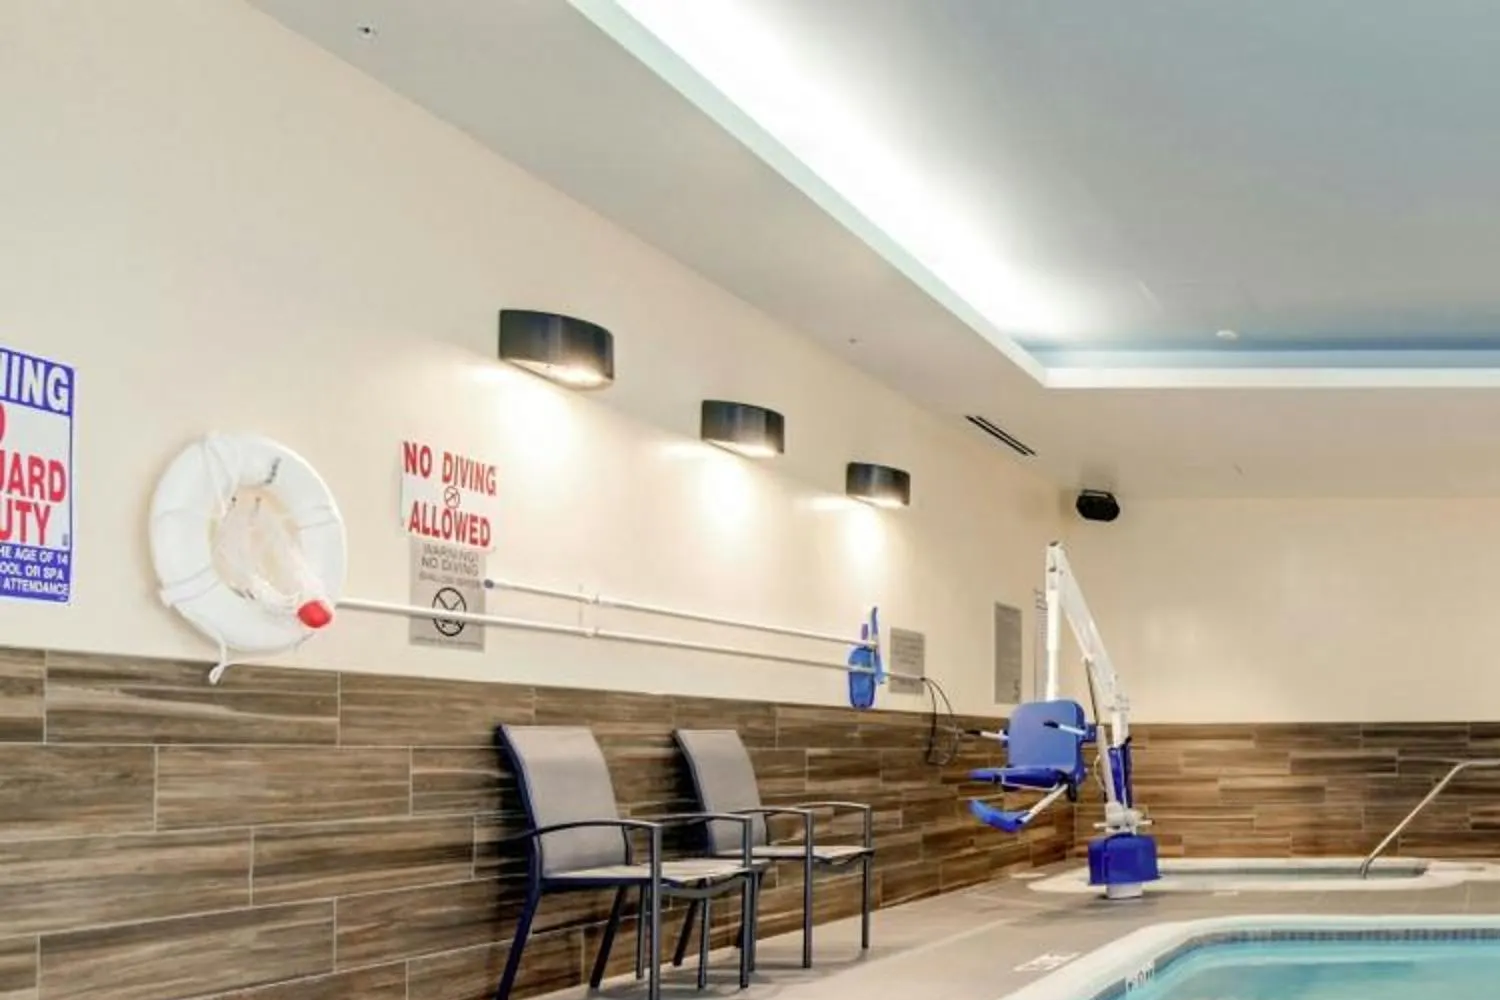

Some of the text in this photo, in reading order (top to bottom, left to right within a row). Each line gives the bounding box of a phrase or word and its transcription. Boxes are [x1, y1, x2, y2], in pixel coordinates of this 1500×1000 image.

[0, 450, 66, 502] ARD
[403, 441, 496, 496] NO DIVING
[408, 500, 491, 547] ALLOWED
[3, 577, 69, 595] ATTENDANCE
[422, 556, 479, 577] NO DIVING
